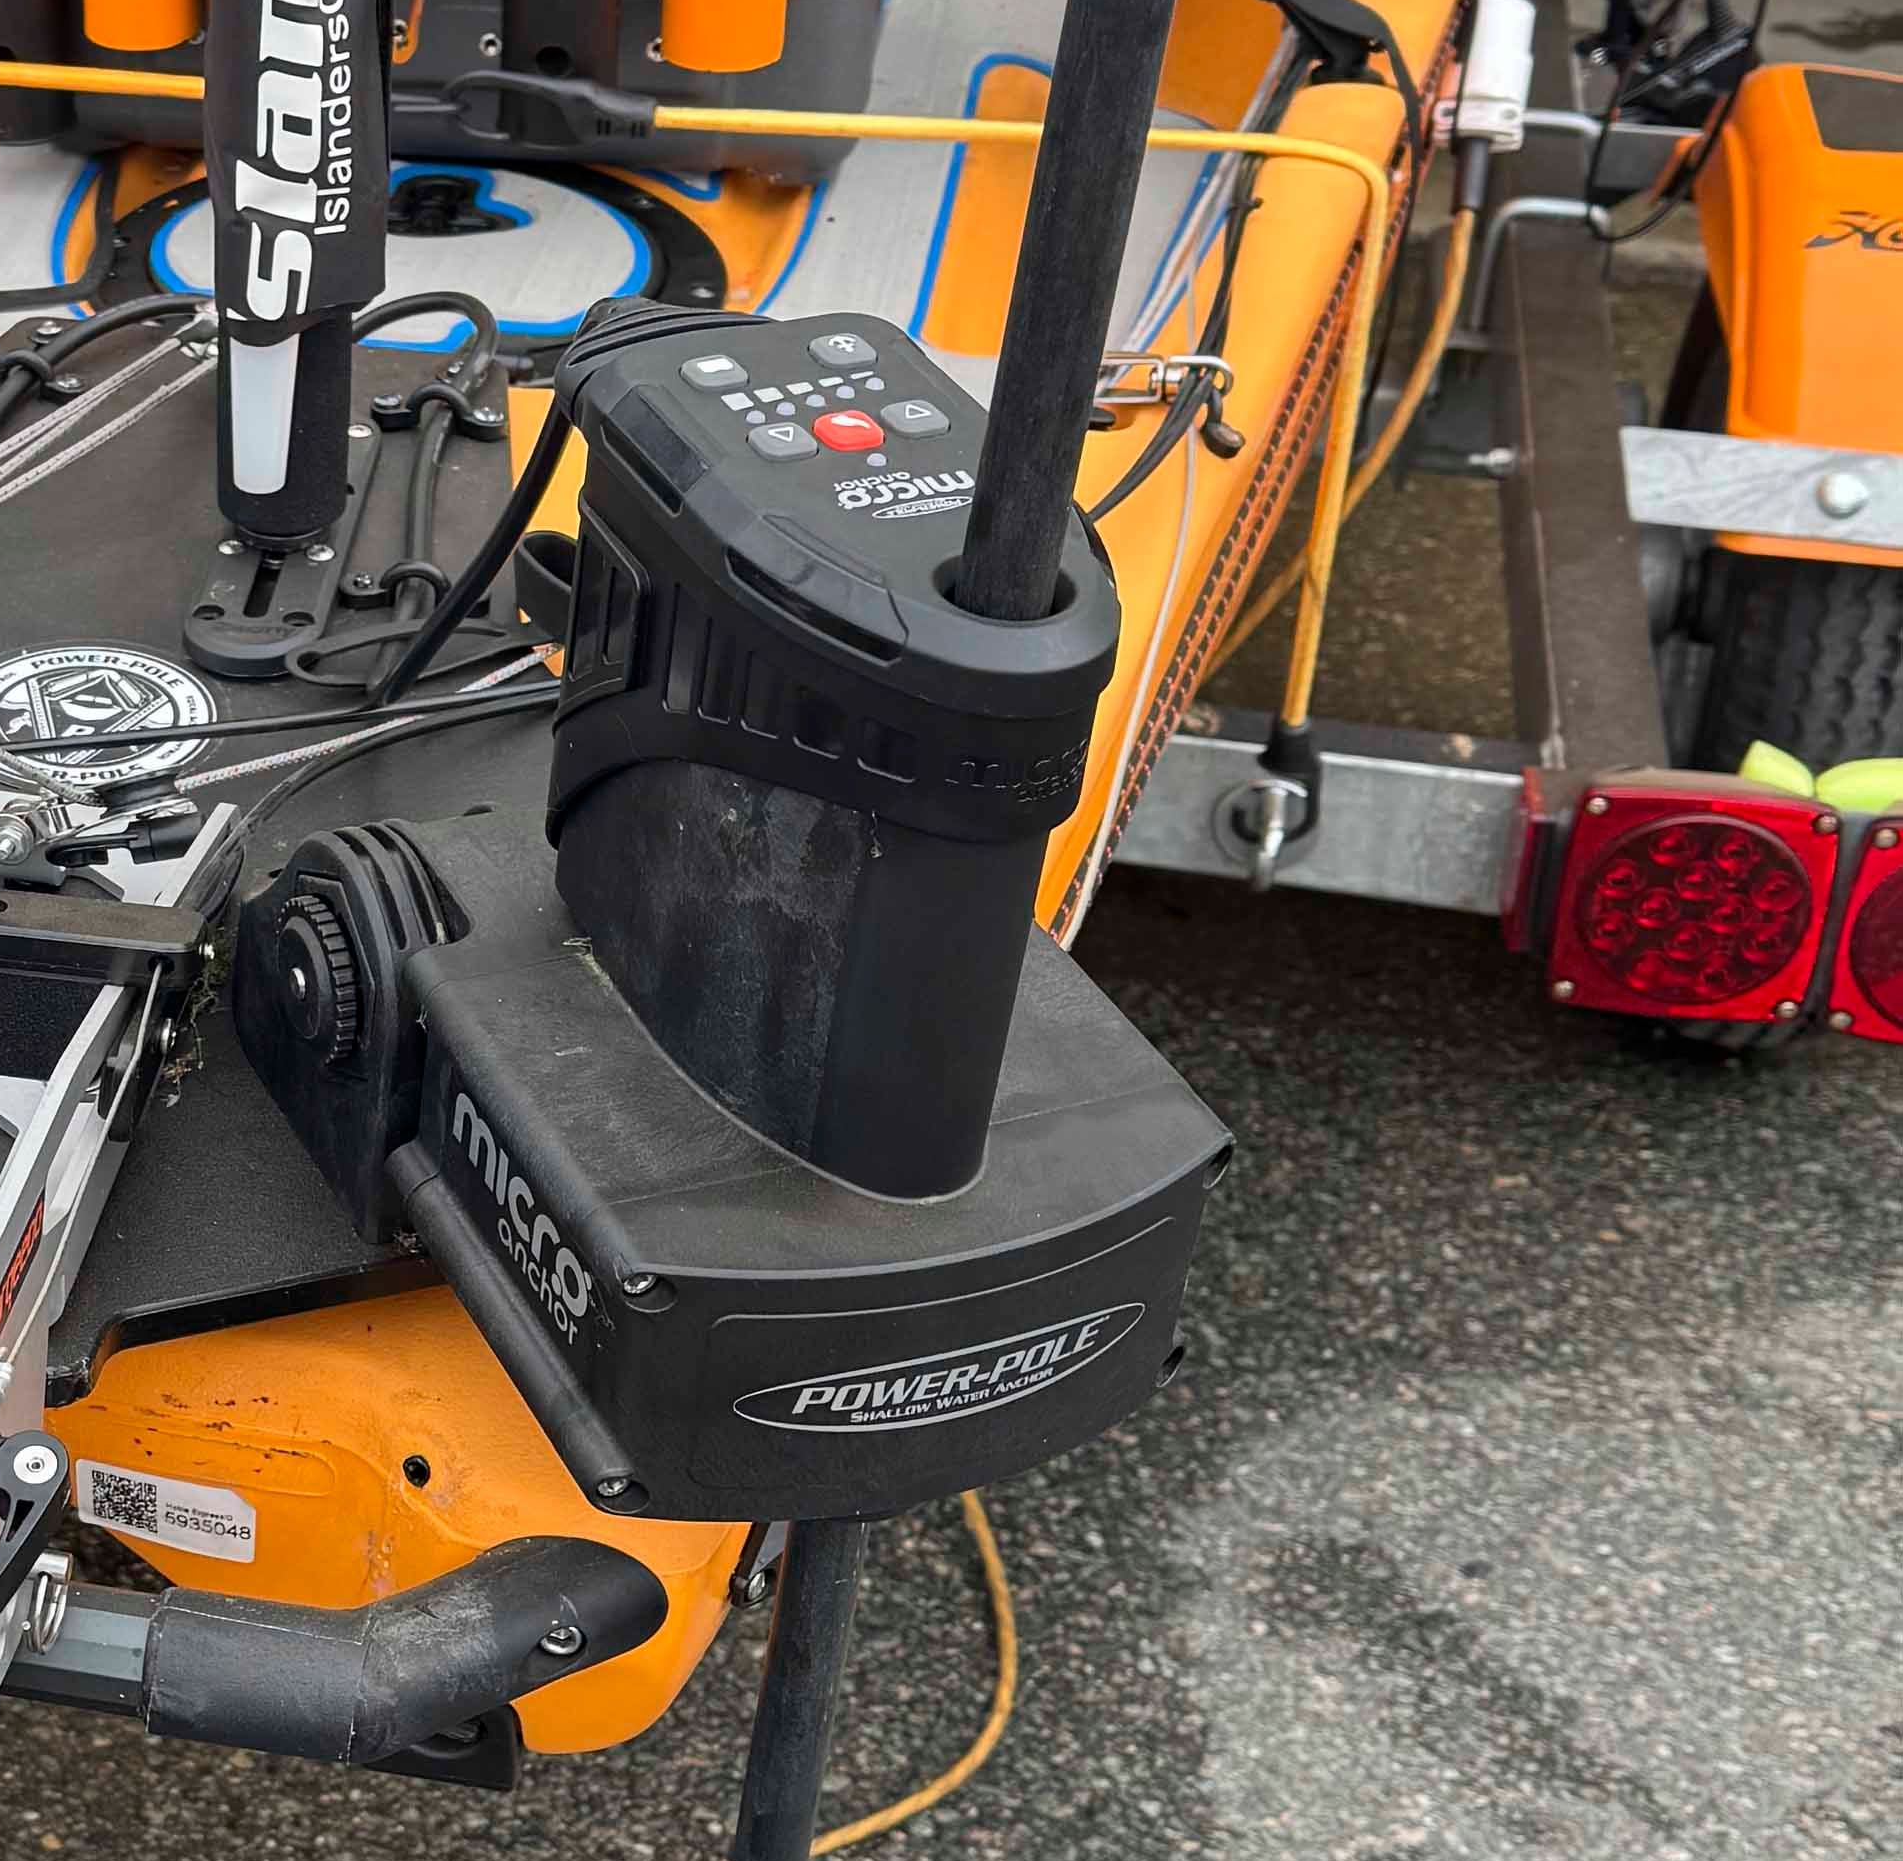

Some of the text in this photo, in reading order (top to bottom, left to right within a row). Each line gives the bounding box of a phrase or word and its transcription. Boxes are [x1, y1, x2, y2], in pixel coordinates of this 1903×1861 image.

[834, 470, 911, 492] anchor
[836, 470, 976, 510] micro
[31, 653, 185, 689] POWER-POLE
[452, 1092, 593, 1318] micro
[496, 1217, 578, 1345] anchor
[791, 1316, 1107, 1414] POWER-POLE
[936, 1388, 991, 1410] WATER
[993, 1366, 1056, 1395] ANCHOR
